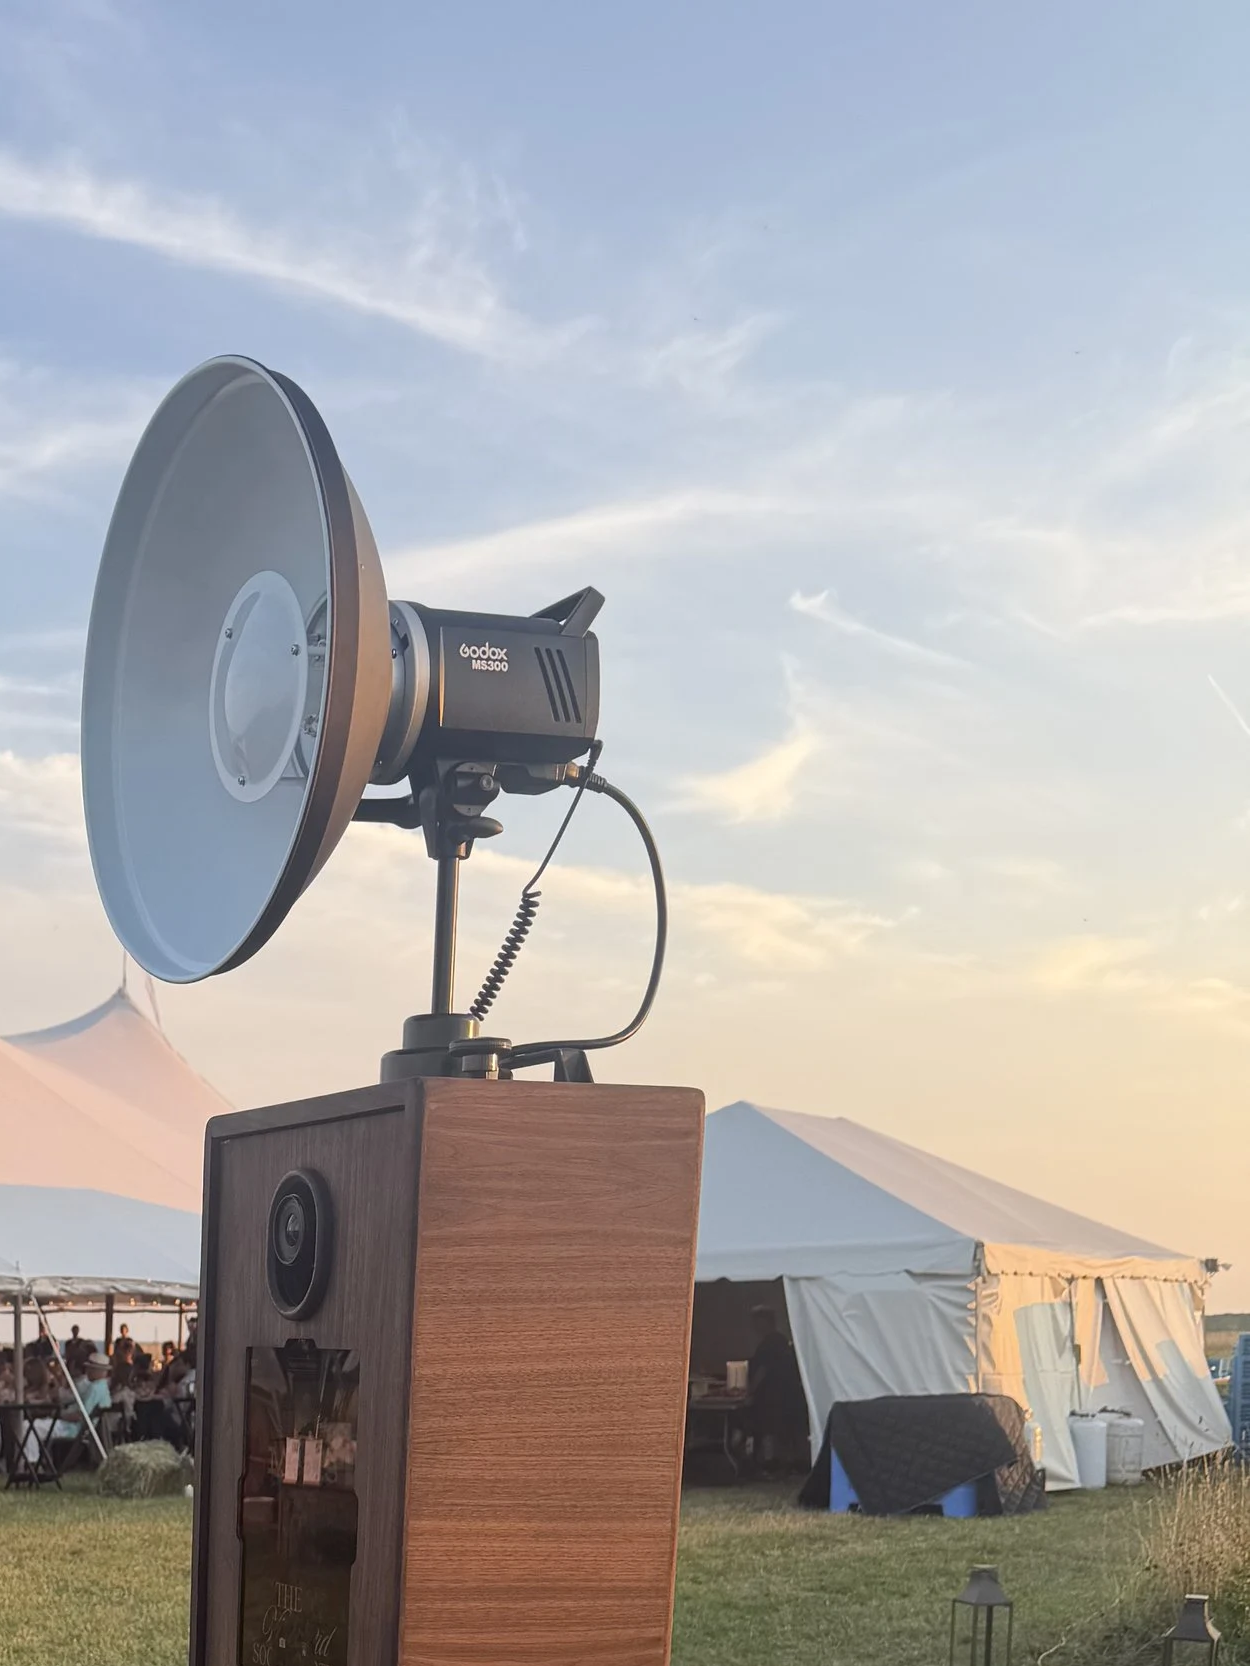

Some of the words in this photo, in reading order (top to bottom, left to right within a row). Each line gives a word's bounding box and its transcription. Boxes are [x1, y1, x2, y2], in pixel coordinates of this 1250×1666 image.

[459, 641, 508, 661] Godox
[471, 659, 509, 672] MS300
[275, 1581, 303, 1613] THE
